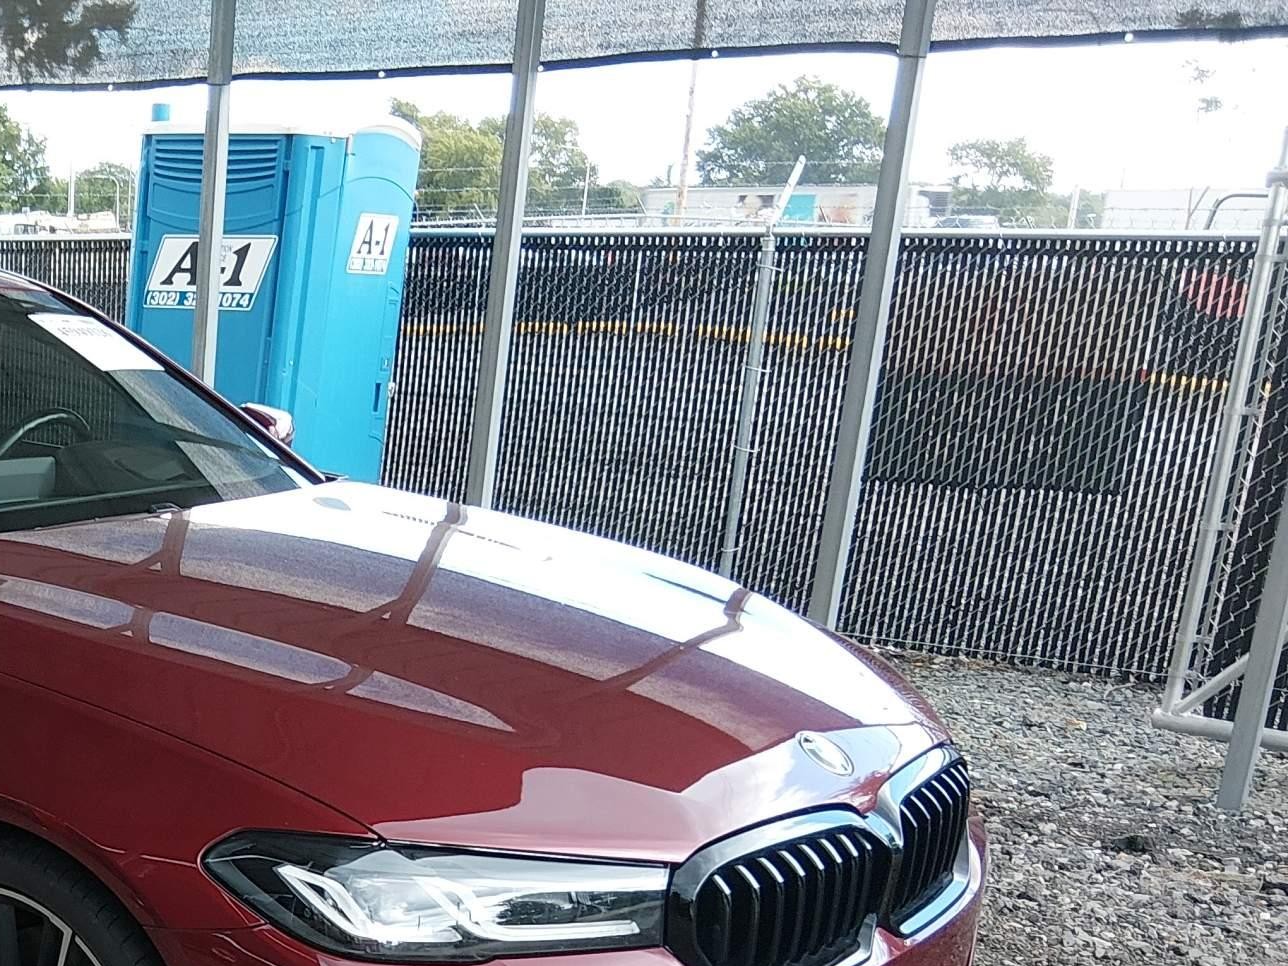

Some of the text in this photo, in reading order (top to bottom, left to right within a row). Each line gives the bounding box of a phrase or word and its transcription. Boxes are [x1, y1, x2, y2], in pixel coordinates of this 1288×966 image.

[356, 219, 390, 255] A-1
[160, 241, 251, 287] A-1
[146, 291, 179, 306] (302)
